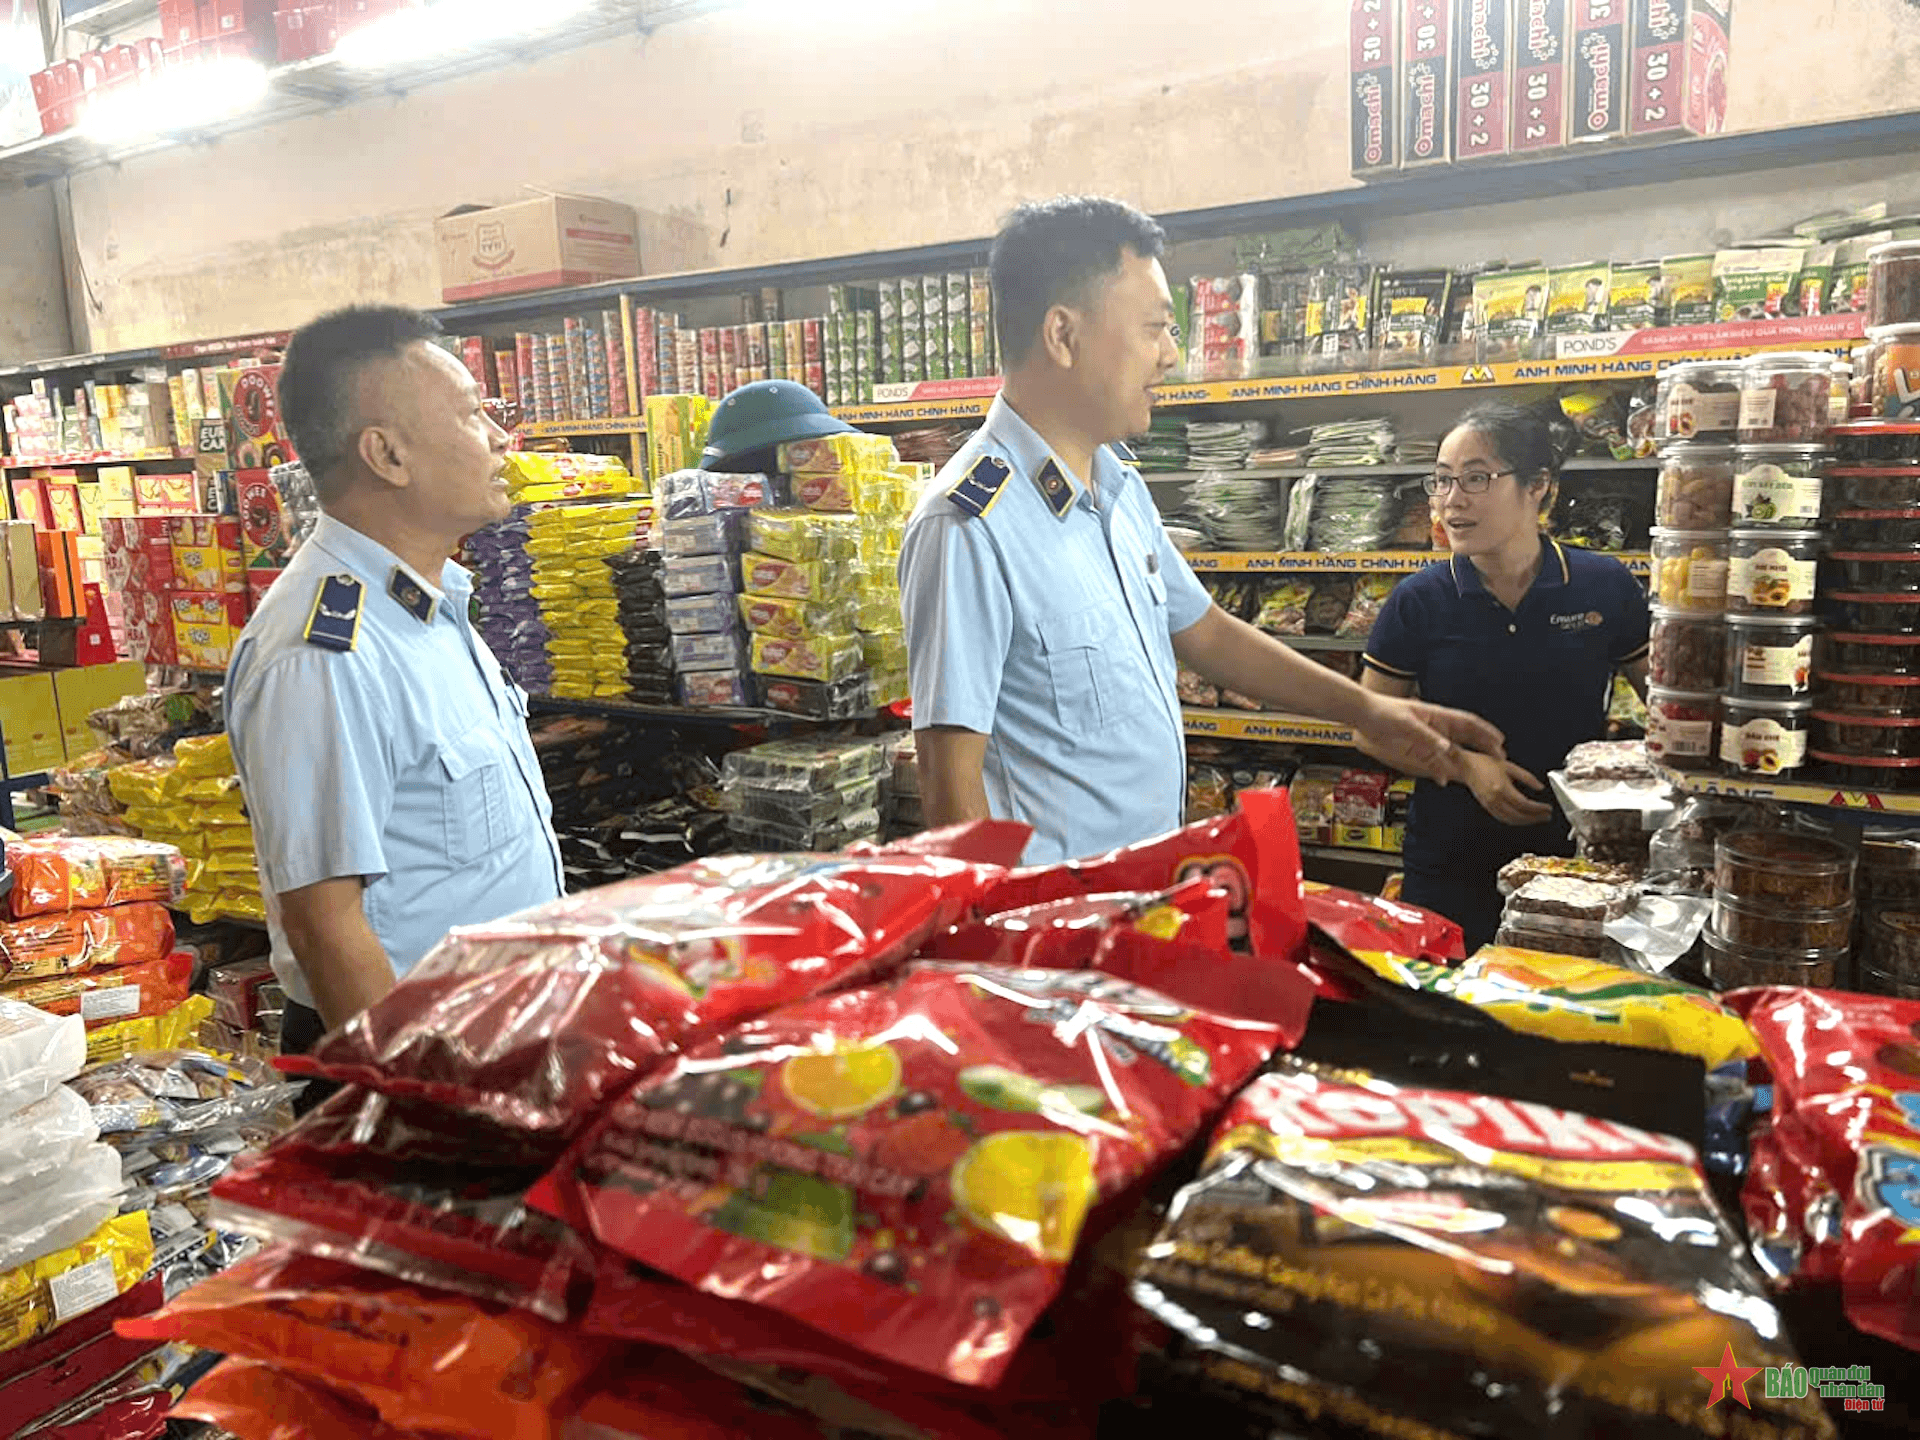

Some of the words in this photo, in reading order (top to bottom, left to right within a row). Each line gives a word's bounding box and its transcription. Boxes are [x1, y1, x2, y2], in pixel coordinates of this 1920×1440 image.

[1363, 36, 1382, 62] 30
[1417, 24, 1436, 52] 30
[1647, 53, 1669, 81] 30
[1470, 82, 1490, 109] 30
[1527, 72, 1548, 100] 30
[1645, 106, 1666, 122] 2
[1470, 132, 1489, 147] 2
[1526, 125, 1546, 139] 2
[1563, 336, 1618, 353] POND'S
[1515, 366, 1549, 379] ANH
[1555, 360, 1597, 375] MINH
[1600, 356, 1650, 372] HÀNG
[1231, 387, 1260, 399] ANH
[1263, 384, 1299, 397] MINH
[1302, 379, 1342, 394] HÀNG
[1345, 374, 1391, 391] CHÍNH
[1393, 370, 1437, 387] HÀNG
[1246, 559, 1275, 569] ANH
[1279, 557, 1312, 568] MINH
[1316, 555, 1356, 569] HÀNG
[1361, 556, 1404, 569] CHÍNH
[1245, 726, 1273, 735] ANH
[1275, 728, 1308, 737] MINH
[1310, 729, 1353, 741] HÀNG
